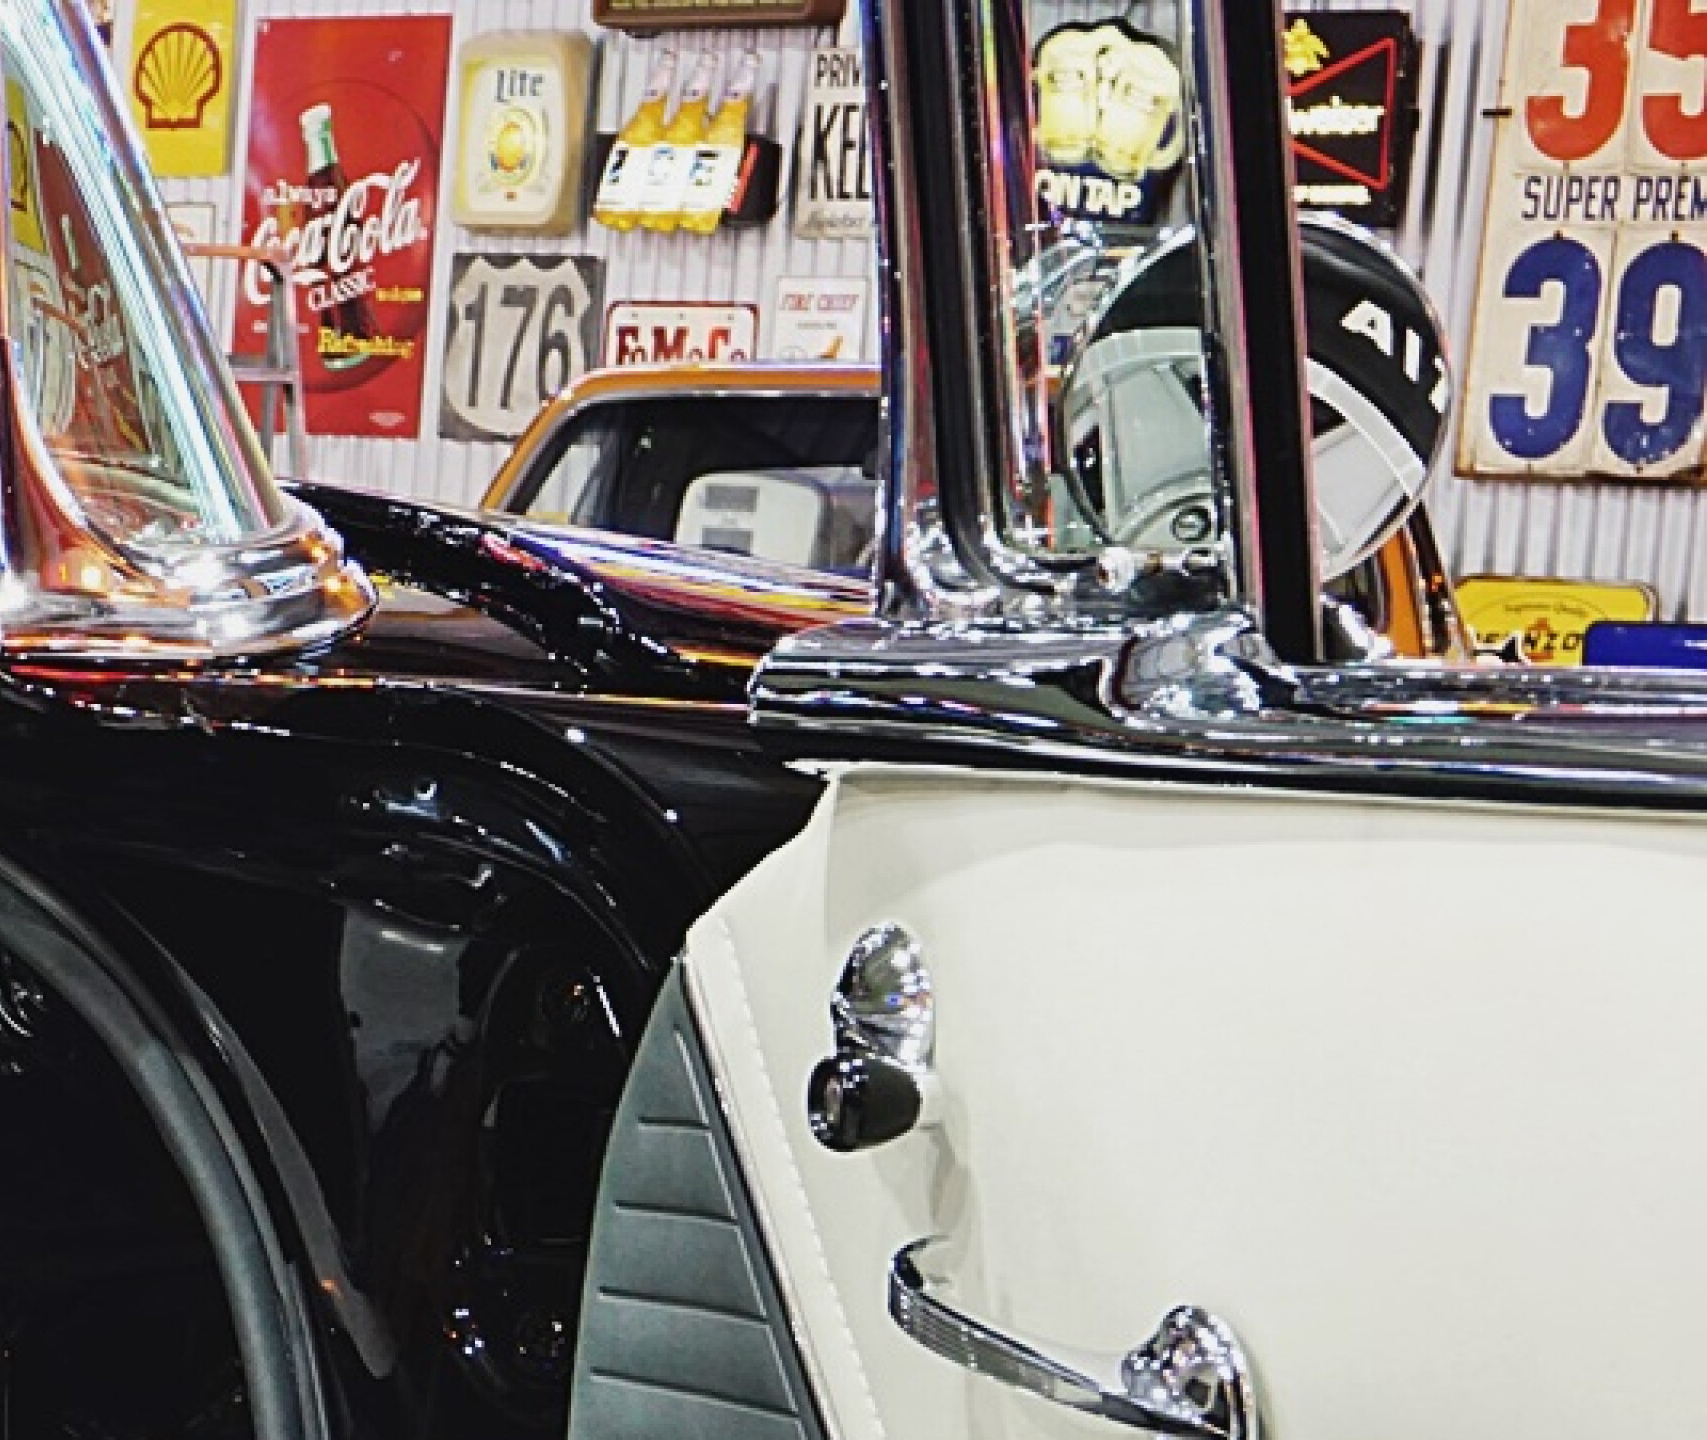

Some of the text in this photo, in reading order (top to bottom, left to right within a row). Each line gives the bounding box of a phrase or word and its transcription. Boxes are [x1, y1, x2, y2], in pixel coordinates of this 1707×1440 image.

[495, 68, 544, 104] Lite
[1083, 177, 1143, 217] TAP
[1521, 176, 1621, 221] SUPER
[463, 282, 575, 410] 176
[1490, 238, 1707, 464] 39
